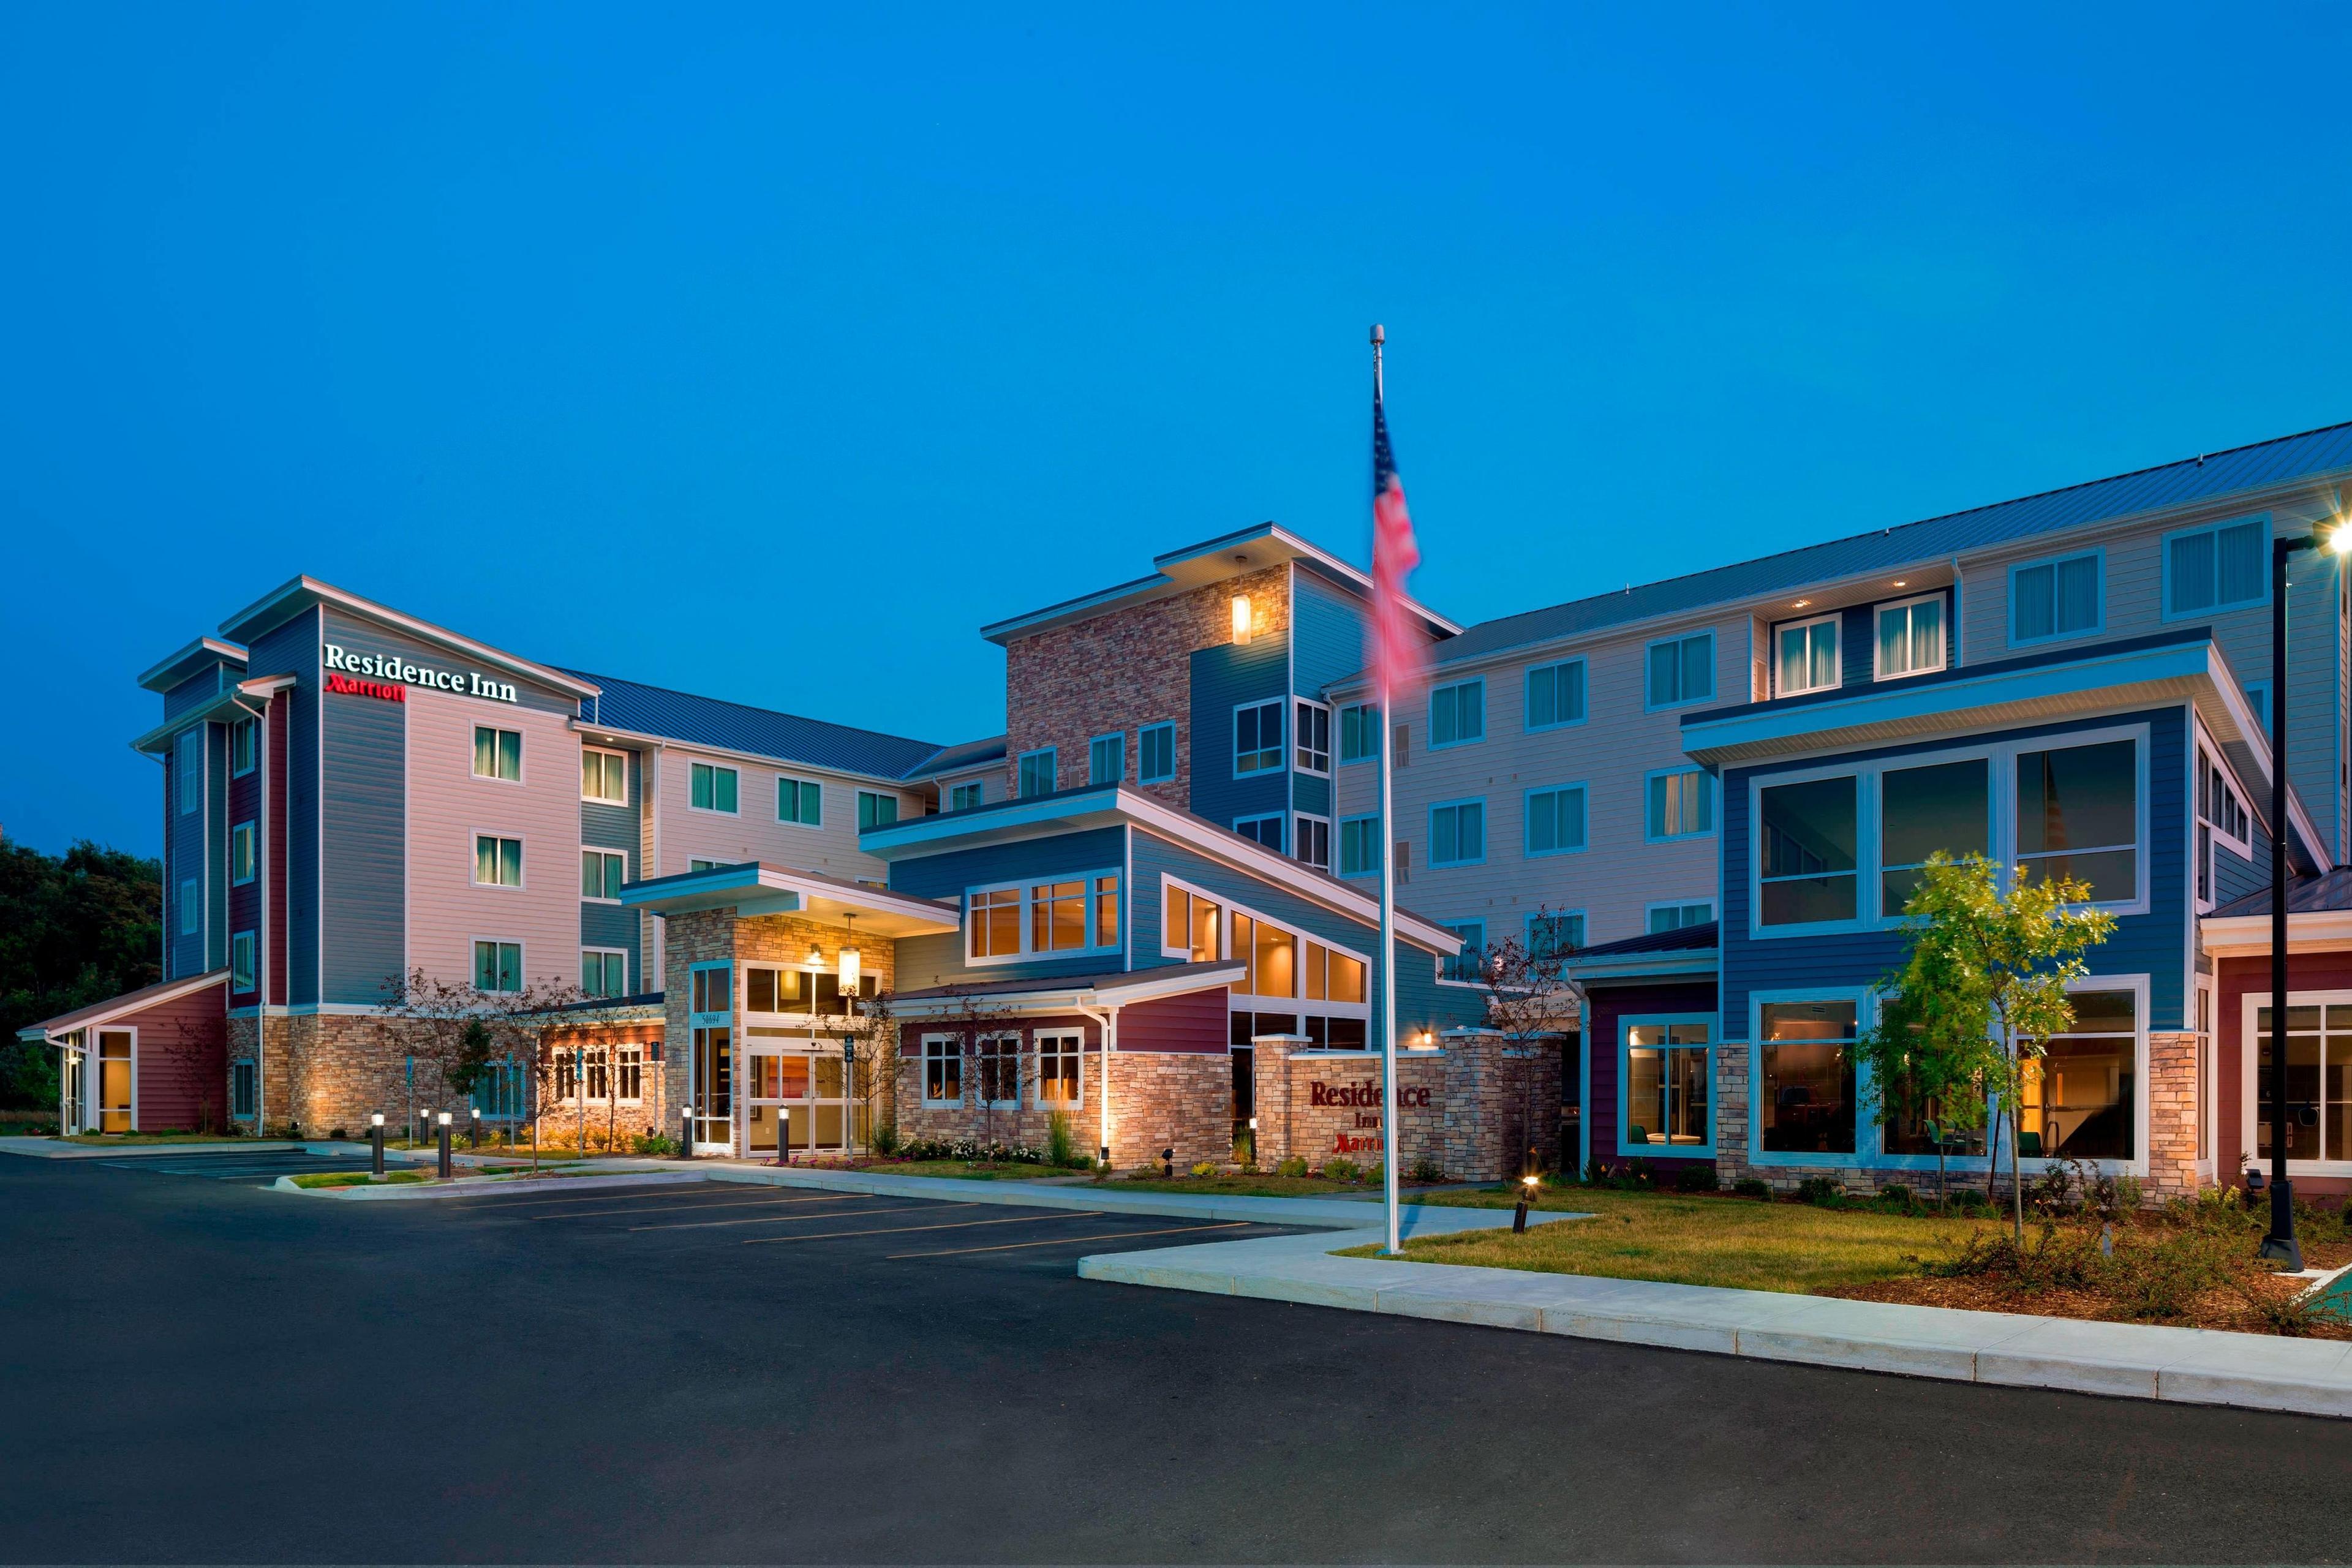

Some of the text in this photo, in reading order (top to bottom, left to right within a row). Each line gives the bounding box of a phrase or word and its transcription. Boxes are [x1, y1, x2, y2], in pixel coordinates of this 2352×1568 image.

[325, 644, 518, 703] Residence Inn
[325, 673, 407, 703] Marriott
[1355, 1112, 1383, 1128] Inn
[1333, 1134, 1401, 1153] Marri
